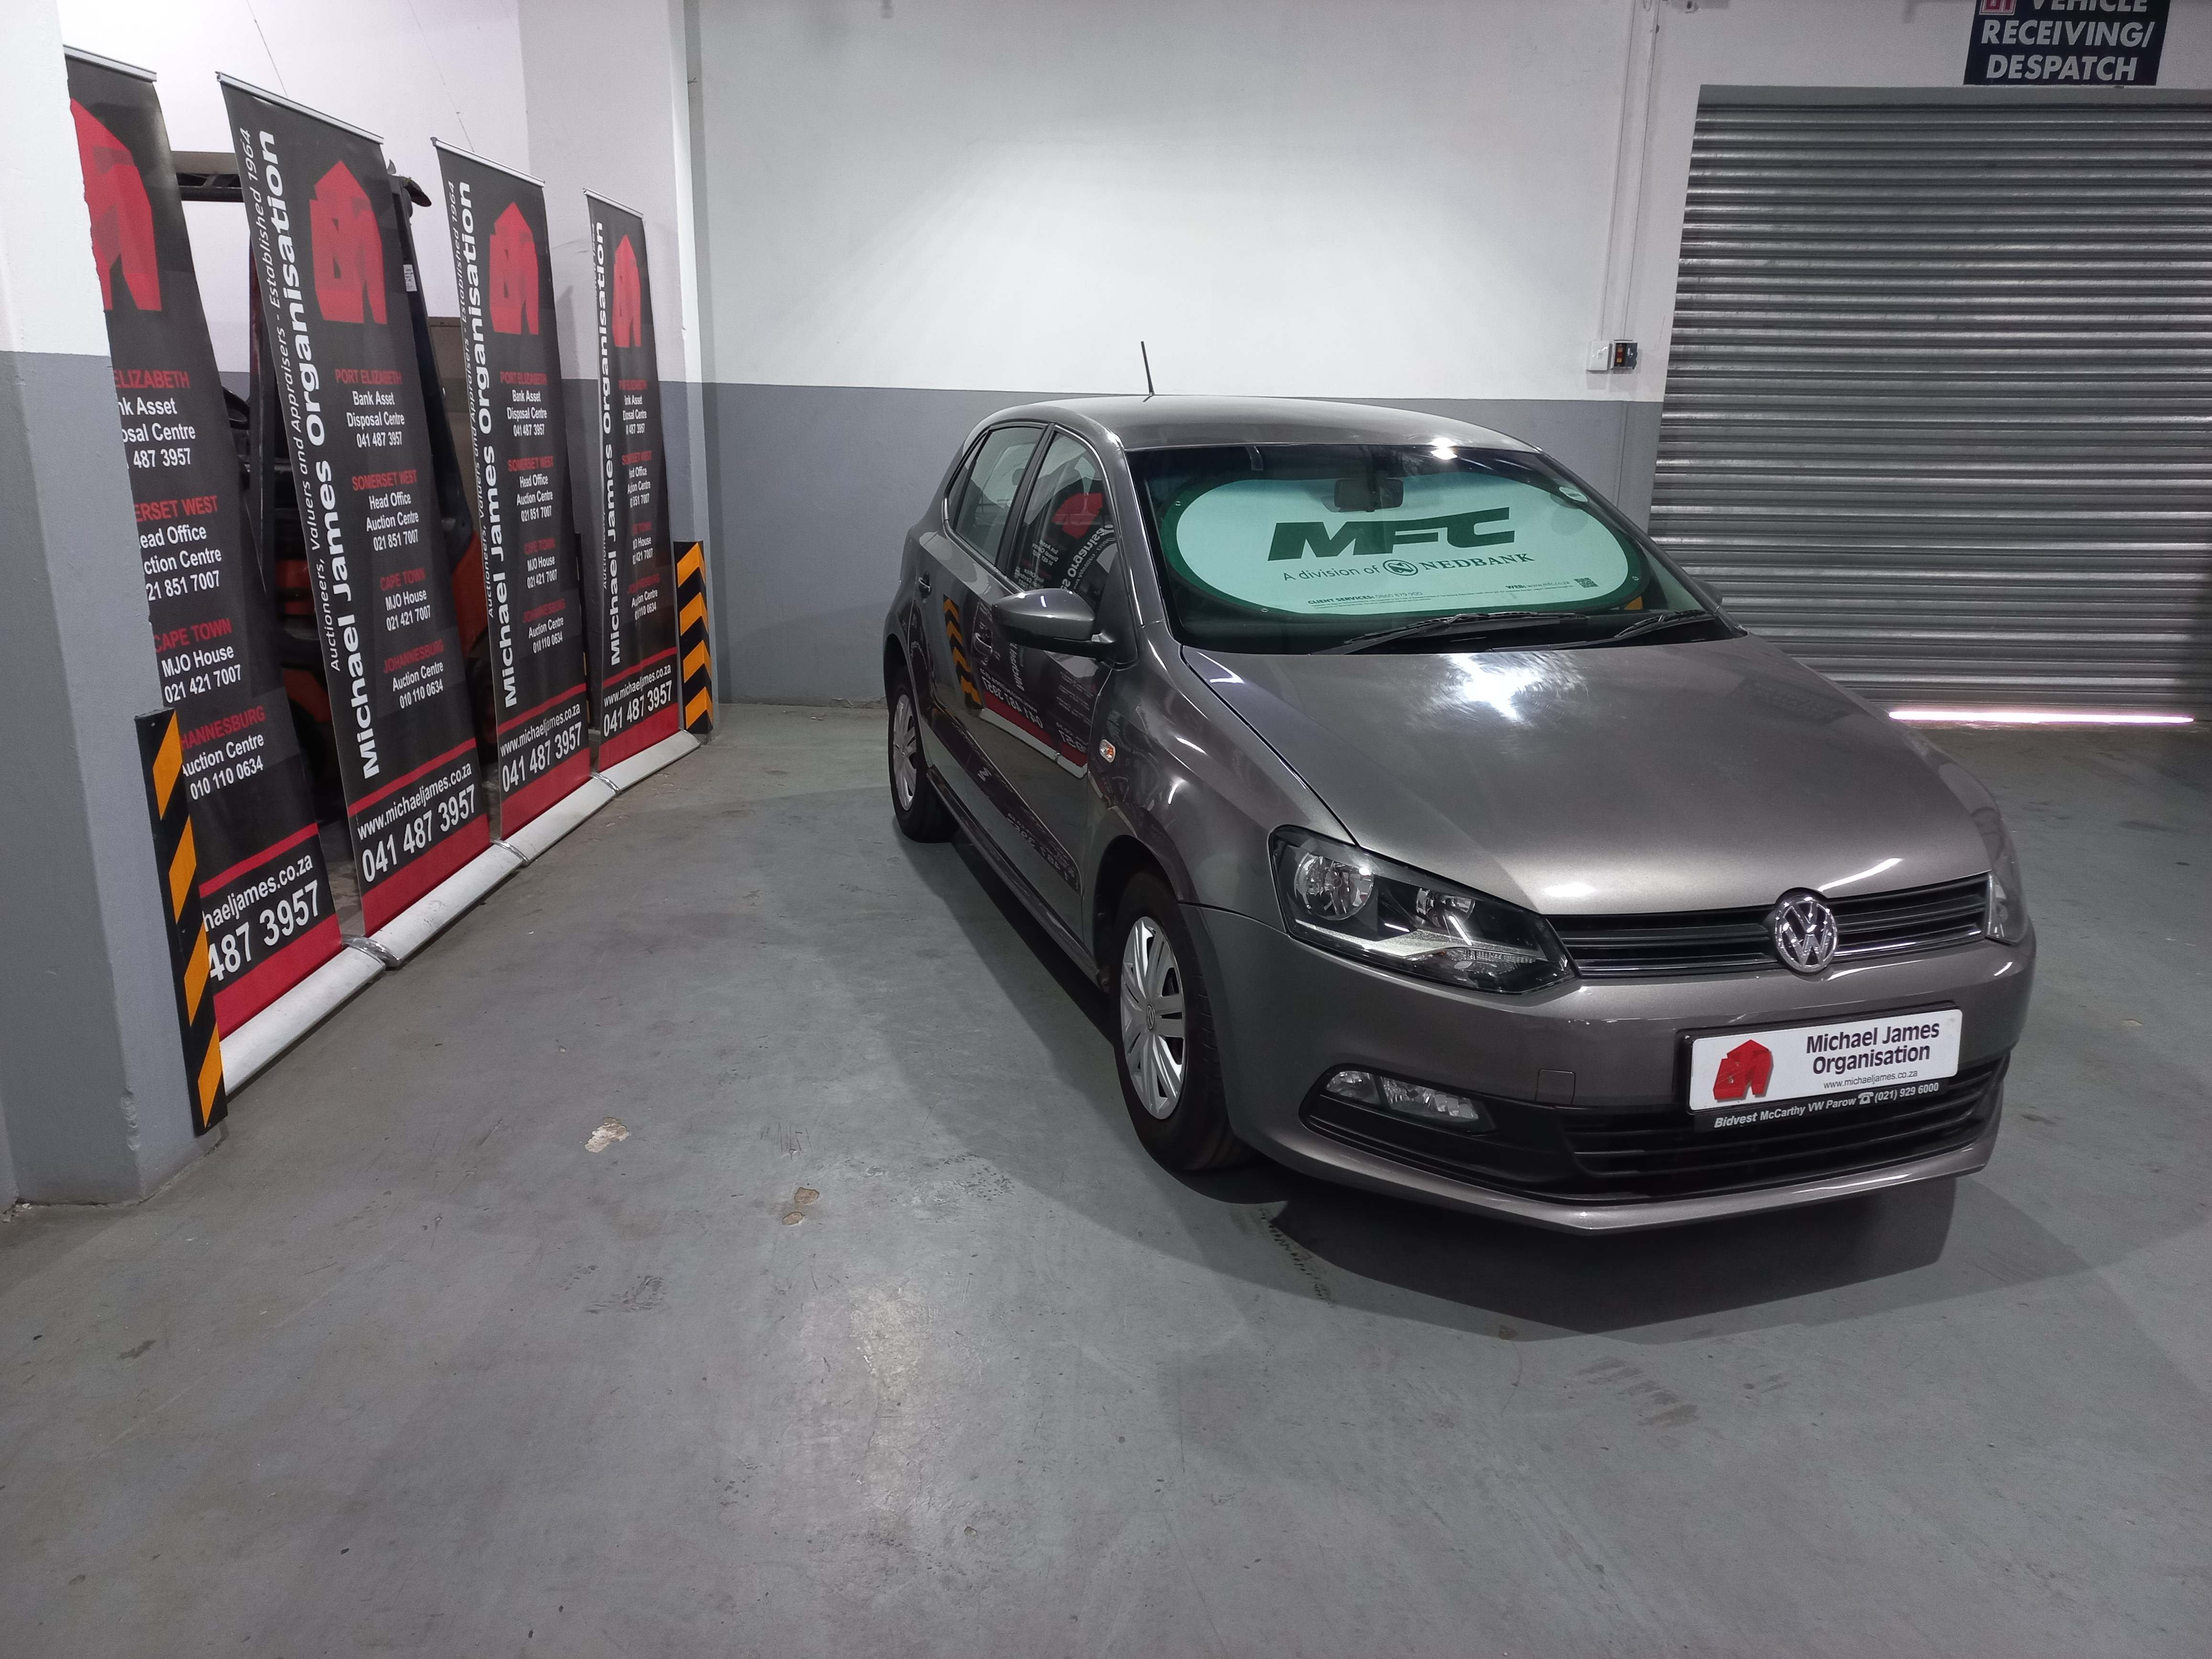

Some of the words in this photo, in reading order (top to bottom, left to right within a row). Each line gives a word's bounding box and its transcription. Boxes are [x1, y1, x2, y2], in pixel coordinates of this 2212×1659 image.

[1981, 20, 2155, 47] RECEIVING/
[1986, 55, 2137, 80] DESPATCH
[240, 127, 259, 182] 1964
[448, 180, 457, 222] 1964
[250, 188, 281, 309] Established
[259, 130, 325, 446] Organisation
[459, 182, 492, 434] Organisation
[596, 222, 611, 434] Organisation
[277, 328, 301, 433] Appraisers
[335, 369, 358, 383] PORT
[137, 397, 177, 415] Asset
[352, 390, 374, 406] Bank
[376, 391, 395, 405] Asset
[512, 389, 525, 402] Bank
[526, 390, 541, 402] Asset
[152, 422, 196, 442] Centre
[346, 412, 382, 429] Disposal
[384, 411, 405, 426] Centre
[513, 425, 522, 436] 041
[523, 424, 531, 436] 487
[534, 424, 544, 435] 3957
[356, 433, 370, 448] 041
[373, 432, 386, 447] 487
[388, 431, 402, 445] 3957
[133, 450, 155, 469] 487
[161, 448, 191, 467] 3957
[296, 437, 308, 475] and
[352, 472, 398, 491] SOMERSET
[532, 474, 548, 486] Office
[606, 444, 616, 542] James
[181, 495, 218, 516] WEST
[369, 494, 388, 510] Head
[390, 491, 411, 506] Office
[484, 446, 504, 562] James
[537, 490, 553, 502] Centre
[301, 480, 320, 551] Valuers
[366, 515, 395, 531] Auction
[397, 511, 419, 525] Centre
[530, 508, 539, 520] 851
[541, 505, 552, 518] 7007
[140, 528, 165, 549] ead
[167, 524, 207, 544] Office
[316, 460, 351, 601] James
[374, 537, 387, 551] 021
[388, 533, 401, 548] 851
[403, 530, 418, 545] 7007
[1268, 507, 1515, 561] MFC
[144, 555, 177, 575] ction
[179, 547, 222, 568] Centre
[538, 556, 554, 568] House
[1283, 573, 1296, 582] A
[1299, 566, 1361, 580] division
[1364, 565, 1380, 575] of
[1417, 553, 1535, 571] NEDBANK
[164, 576, 188, 597] 851
[190, 570, 220, 592] 7007
[536, 573, 544, 585] 421
[316, 558, 340, 671] Auctioneers,
[385, 594, 401, 611] MJO
[403, 590, 427, 606] House
[608, 551, 620, 665] Michael
[191, 618, 232, 642] TOWN
[386, 616, 399, 631] 021
[400, 611, 413, 626] 421
[415, 605, 431, 622] 7007
[548, 617, 564, 630] Centre
[493, 573, 517, 708] Michael
[542, 636, 550, 649] 110
[552, 631, 563, 645] 0634
[161, 653, 191, 677] MJO
[193, 646, 234, 668] House
[164, 681, 186, 704] 021
[189, 673, 211, 695] 421
[213, 664, 241, 687] 7007
[393, 671, 419, 692] Auction
[420, 661, 443, 679] Centre
[338, 614, 379, 779] Michael
[399, 691, 411, 709] 010
[413, 687, 425, 702] 110
[426, 678, 443, 697] 0634
[604, 706, 622, 737] 041
[627, 695, 644, 723] 487
[647, 680, 672, 712] 3957
[500, 704, 580, 757] www.michaeljames.co.za
[226, 734, 264, 759] Centre
[502, 755, 525, 792] 041
[530, 740, 550, 774] 487
[554, 721, 581, 759] 3957
[190, 777, 211, 800] 010
[212, 767, 234, 789] 110
[236, 755, 264, 780] 0634
[357, 763, 472, 841] www.michaeljames.co.za
[362, 834, 397, 882] 041
[403, 810, 432, 854] 487
[438, 784, 475, 832] 3957
[209, 921, 251, 981] 487
[260, 879, 318, 946] 3957
[1806, 1027, 1878, 1054] Michael
[1882, 1023, 1940, 1044] James
[1813, 1045, 1930, 1075] Organisation
[1823, 1070, 1918, 1089] www.michaeljames.co.za
[1714, 1112, 1758, 1128] Bidvest
[1760, 1106, 1806, 1121] McCarthy
[1808, 1101, 1824, 1112] VW
[1826, 1097, 1857, 1109] Parow
[1874, 1090, 1897, 1104] (021)
[1900, 1086, 1915, 1097] 929
[1918, 1083, 1939, 1094] 6000
